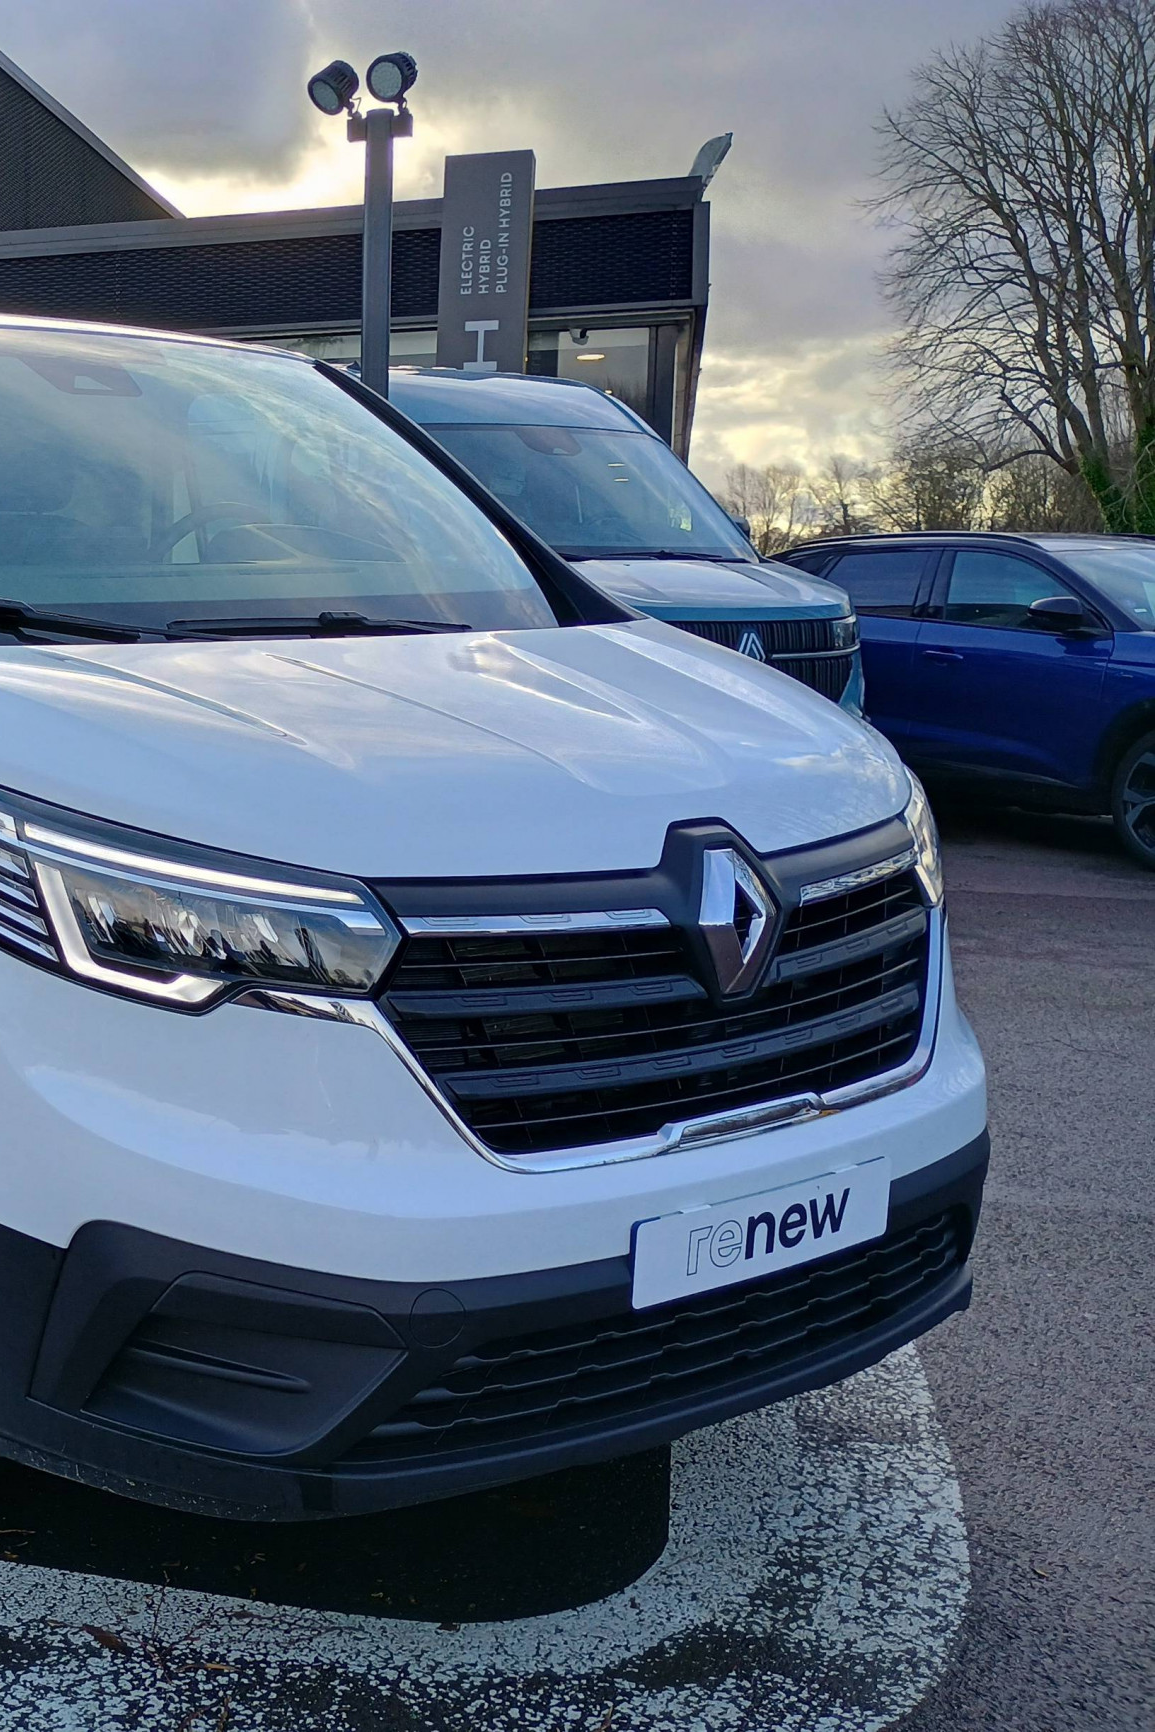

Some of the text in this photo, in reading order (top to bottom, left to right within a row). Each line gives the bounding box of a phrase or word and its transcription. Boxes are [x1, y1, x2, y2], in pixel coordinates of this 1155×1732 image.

[460, 225, 475, 295] ELECTRIC
[478, 238, 492, 294] HYBRID
[495, 171, 513, 293] PLUG-IN HYBRID
[687, 1187, 851, 1276] renew
